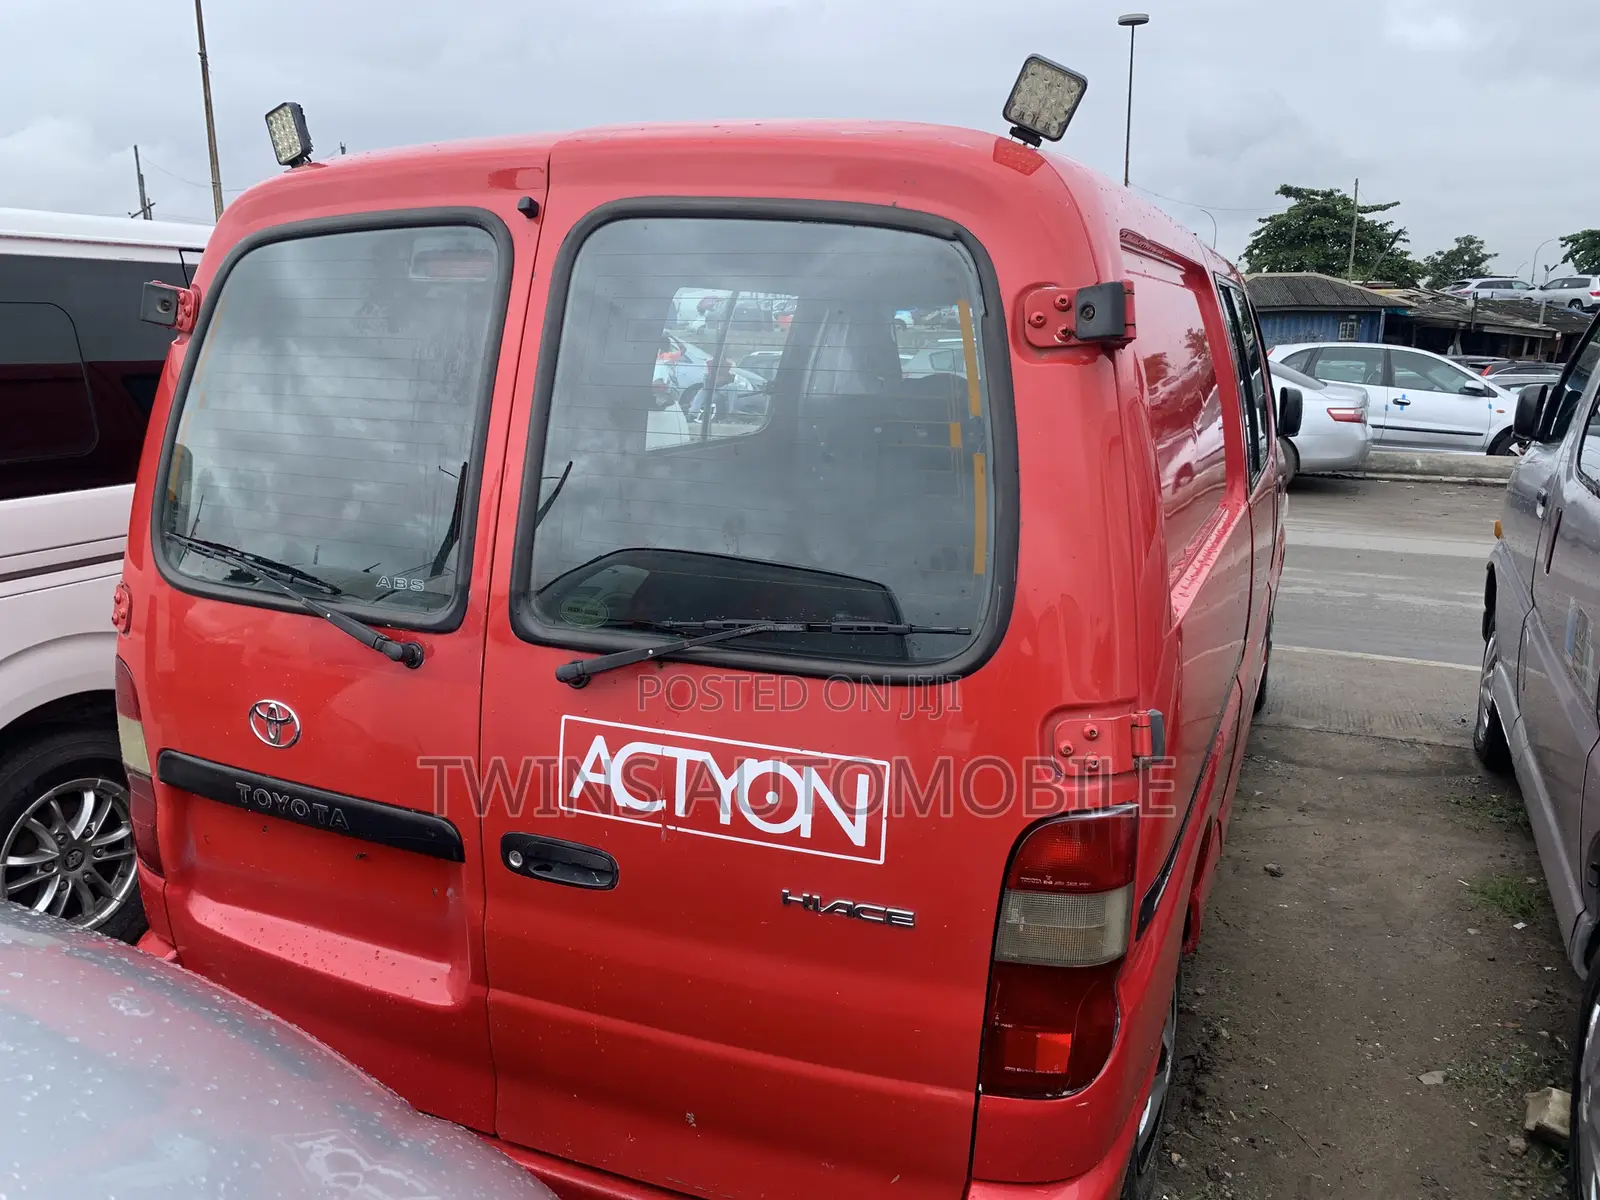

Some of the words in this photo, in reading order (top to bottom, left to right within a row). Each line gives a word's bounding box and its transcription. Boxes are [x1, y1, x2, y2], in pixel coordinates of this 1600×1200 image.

[376, 575, 425, 592] ABS
[235, 781, 350, 831] TOYOTA
[569, 734, 870, 847] ACTYON
[781, 888, 916, 929] HIACE
